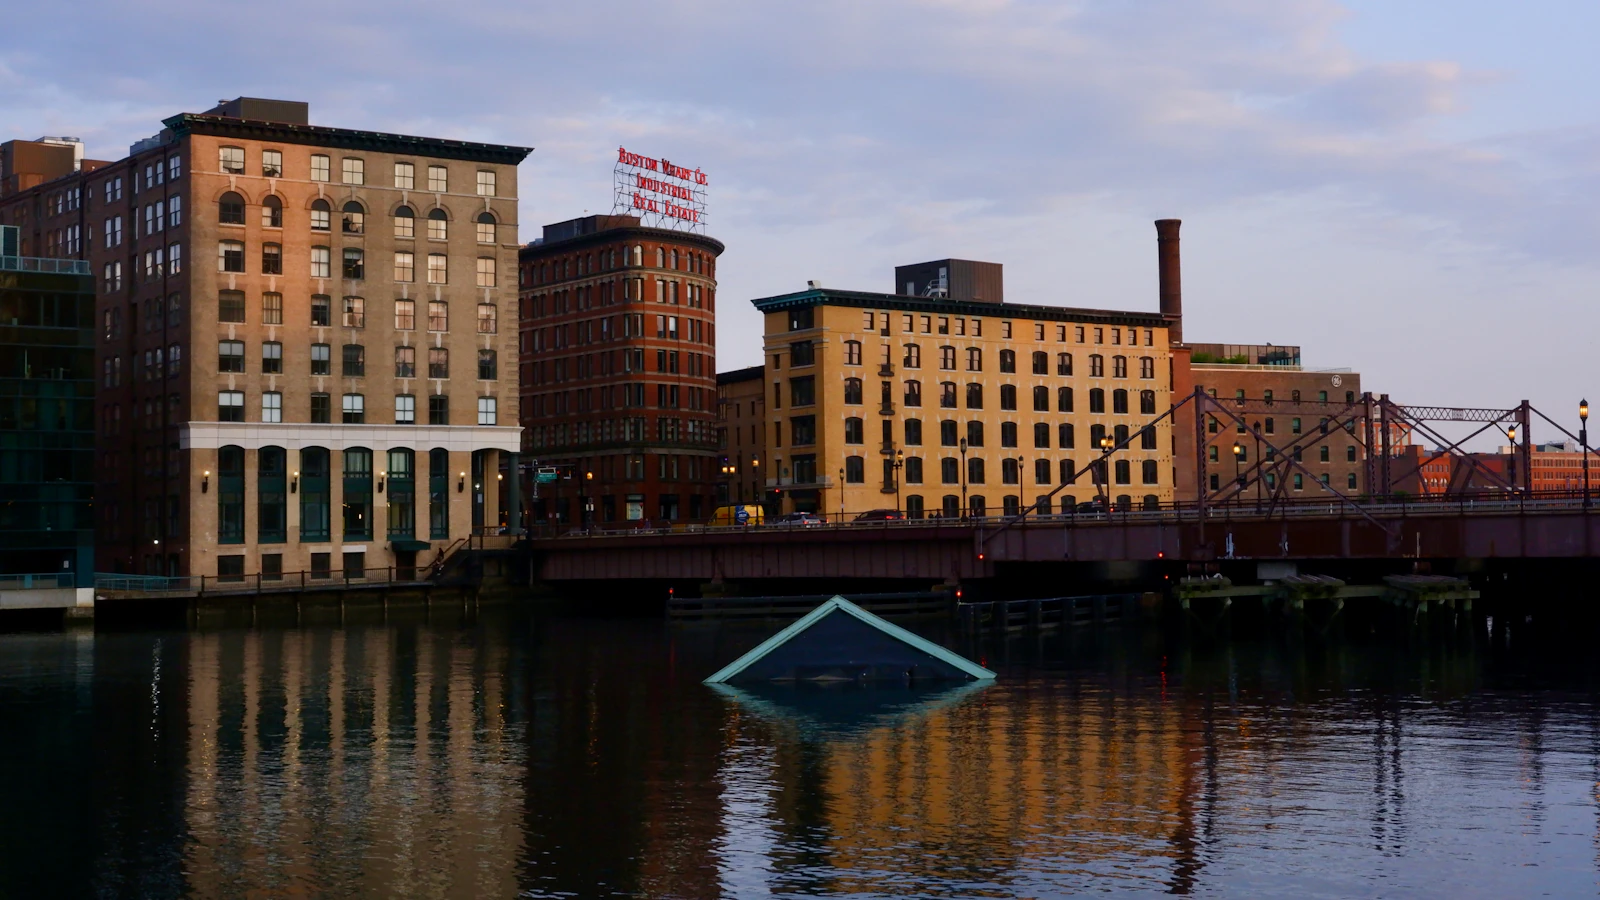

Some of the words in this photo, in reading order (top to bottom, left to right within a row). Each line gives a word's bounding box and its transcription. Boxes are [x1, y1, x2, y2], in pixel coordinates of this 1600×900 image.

[619, 147, 658, 172] BOSTON
[637, 172, 693, 202] INDUSTRIAL
[633, 192, 660, 213] REAL
[665, 200, 699, 223] ESTATE
